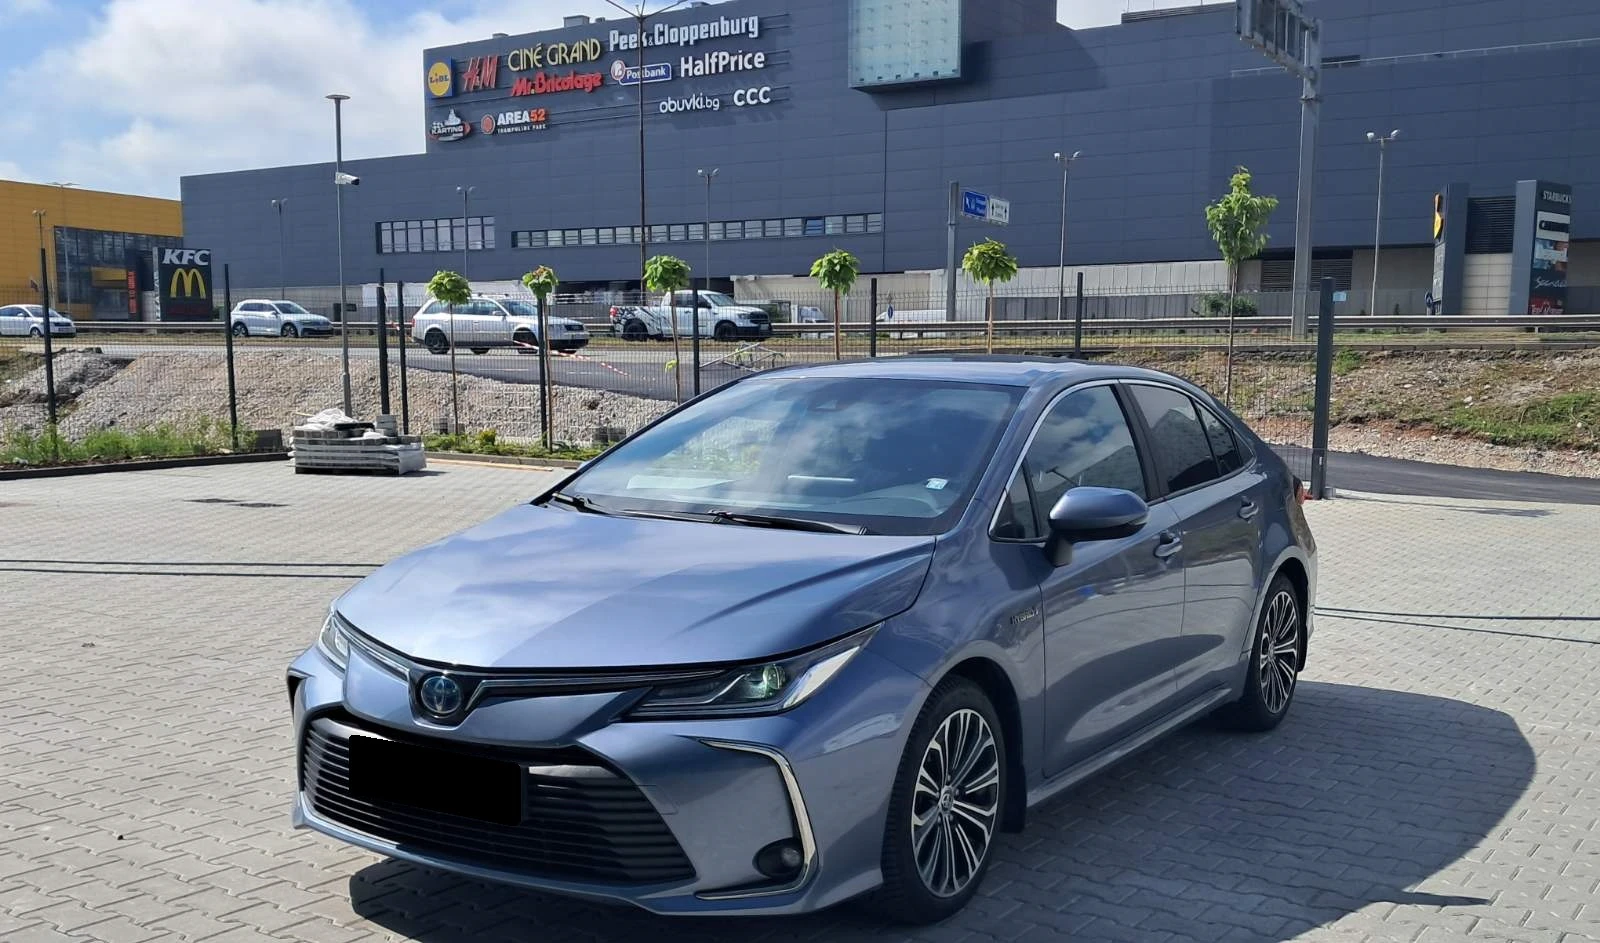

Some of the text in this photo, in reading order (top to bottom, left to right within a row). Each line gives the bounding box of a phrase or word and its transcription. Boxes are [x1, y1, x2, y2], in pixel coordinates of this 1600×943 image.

[508, 38, 600, 72] CINÉ GRAND
[680, 50, 765, 78] HalfPrice
[463, 55, 498, 92] H&M
[659, 92, 720, 114] obuvki.bg
[733, 86, 771, 107] CCC
[431, 125, 464, 135] KARTING
[162, 248, 210, 266] KFC
